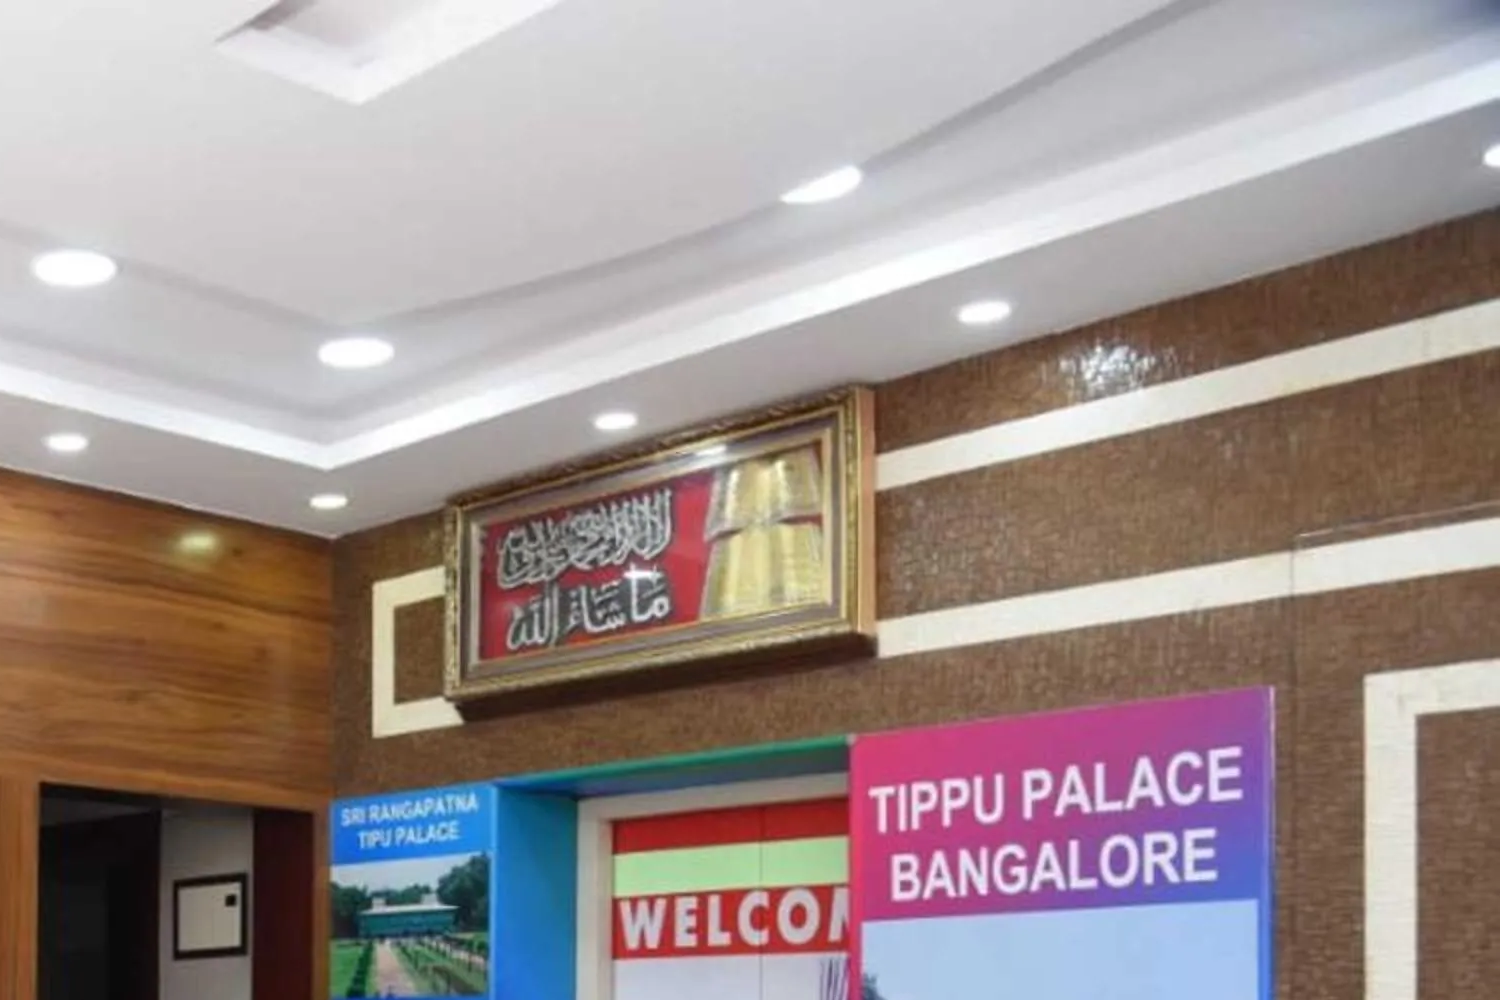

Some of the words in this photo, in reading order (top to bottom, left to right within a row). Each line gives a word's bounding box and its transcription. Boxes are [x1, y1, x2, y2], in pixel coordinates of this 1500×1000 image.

[340, 806, 365, 827] SRI
[368, 790, 479, 824] RANGAPATNA
[868, 772, 1003, 834] TIPPU
[1022, 745, 1243, 820] PALACE
[357, 828, 392, 849] TIPU
[394, 820, 461, 847] PALACE
[890, 827, 1218, 902] BANGALORE
